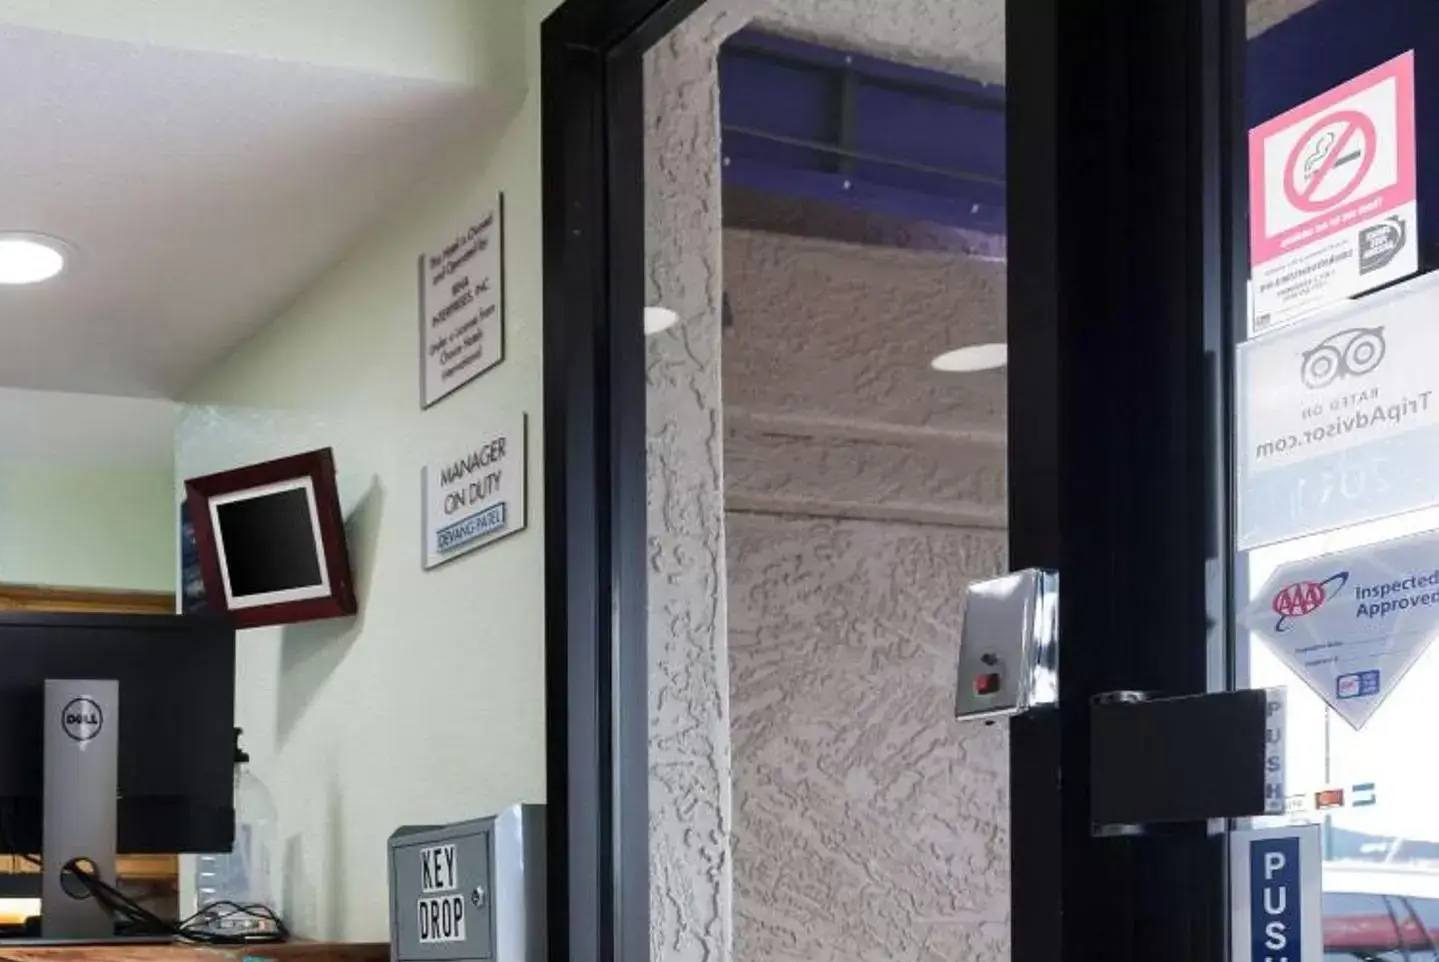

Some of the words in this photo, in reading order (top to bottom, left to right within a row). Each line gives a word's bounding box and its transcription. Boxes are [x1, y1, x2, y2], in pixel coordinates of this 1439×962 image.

[440, 437, 507, 488] MANAGER
[443, 488, 465, 515] ON
[469, 470, 502, 506] DUTY
[1274, 582, 1325, 617] AAA
[1356, 570, 1439, 601] Inspected
[66, 713, 98, 725] DELL
[423, 847, 455, 889] KEY
[419, 898, 464, 940] DROP
